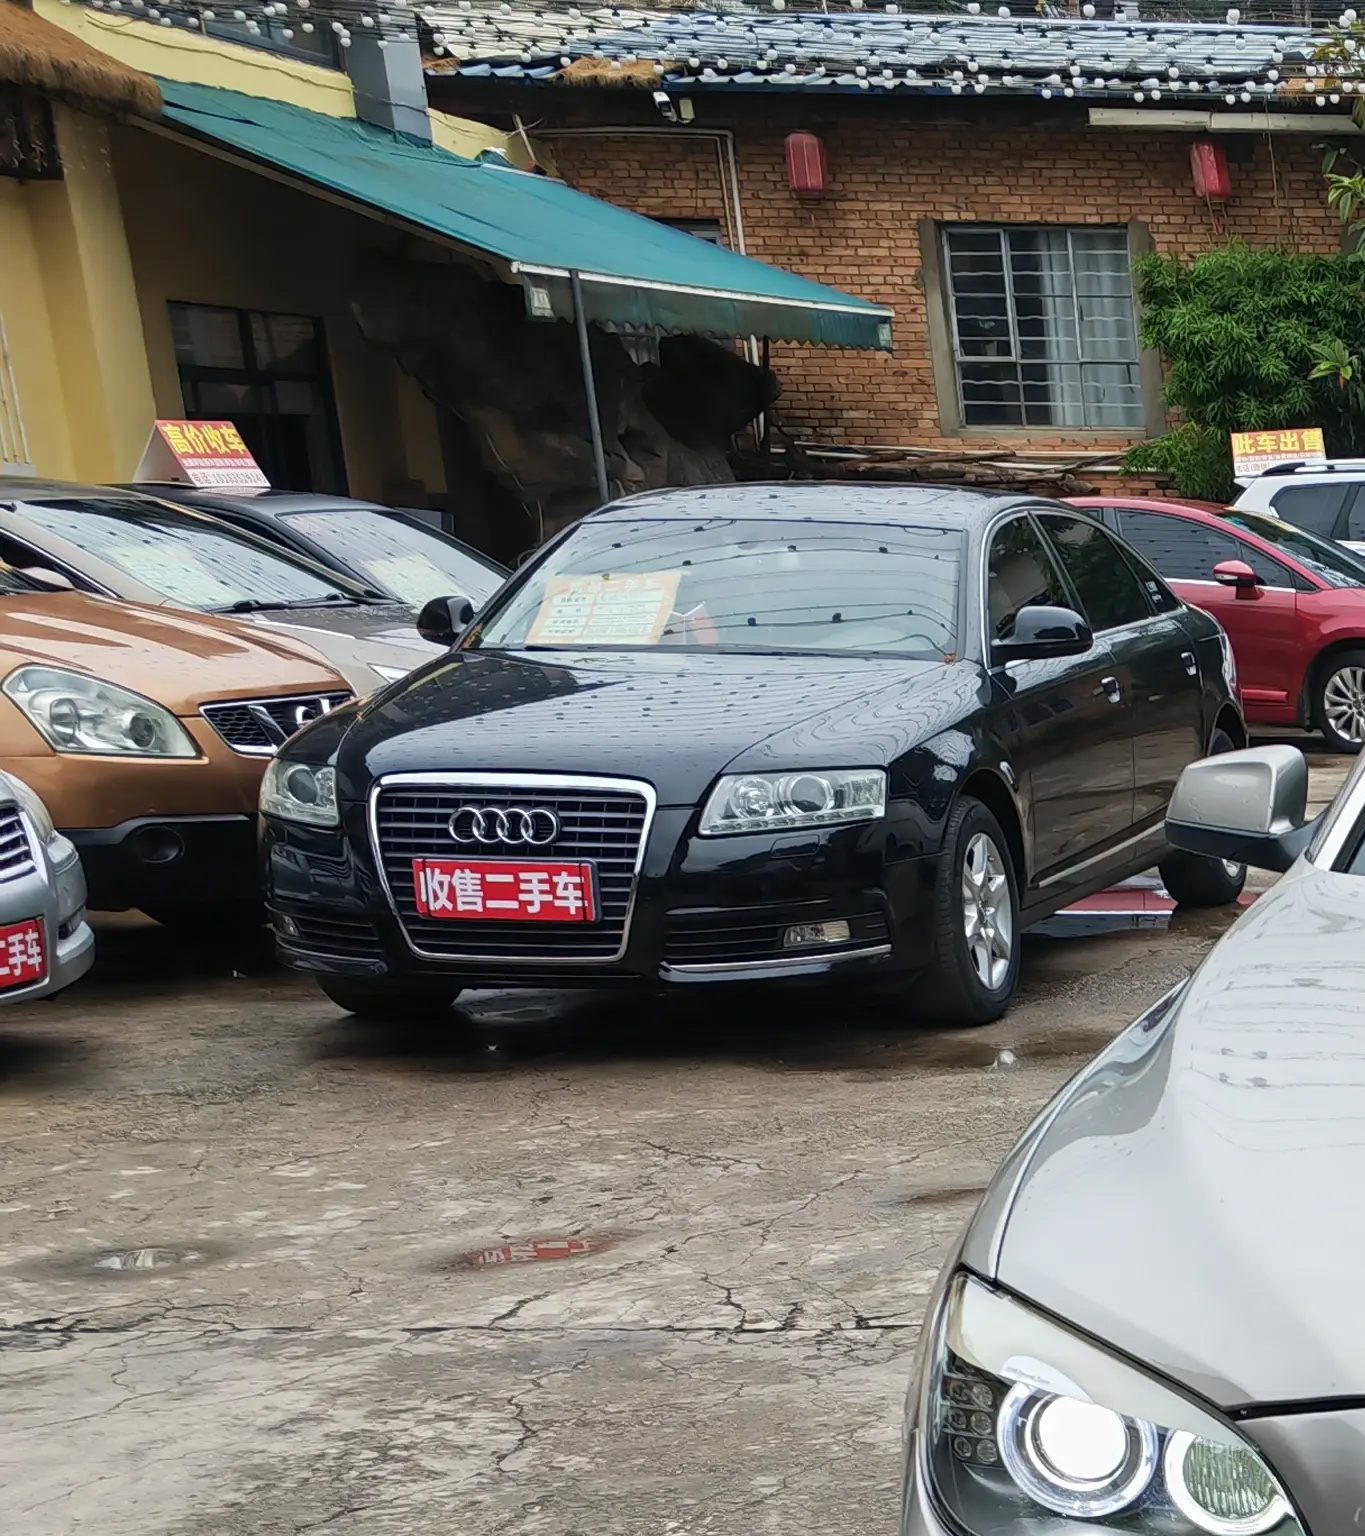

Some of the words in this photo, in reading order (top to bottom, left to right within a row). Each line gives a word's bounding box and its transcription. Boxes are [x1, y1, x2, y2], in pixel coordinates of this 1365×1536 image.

[161, 423, 248, 454] 高价收车
[1233, 430, 1323, 455] 此车出售
[419, 867, 588, 915] 收售二手车
